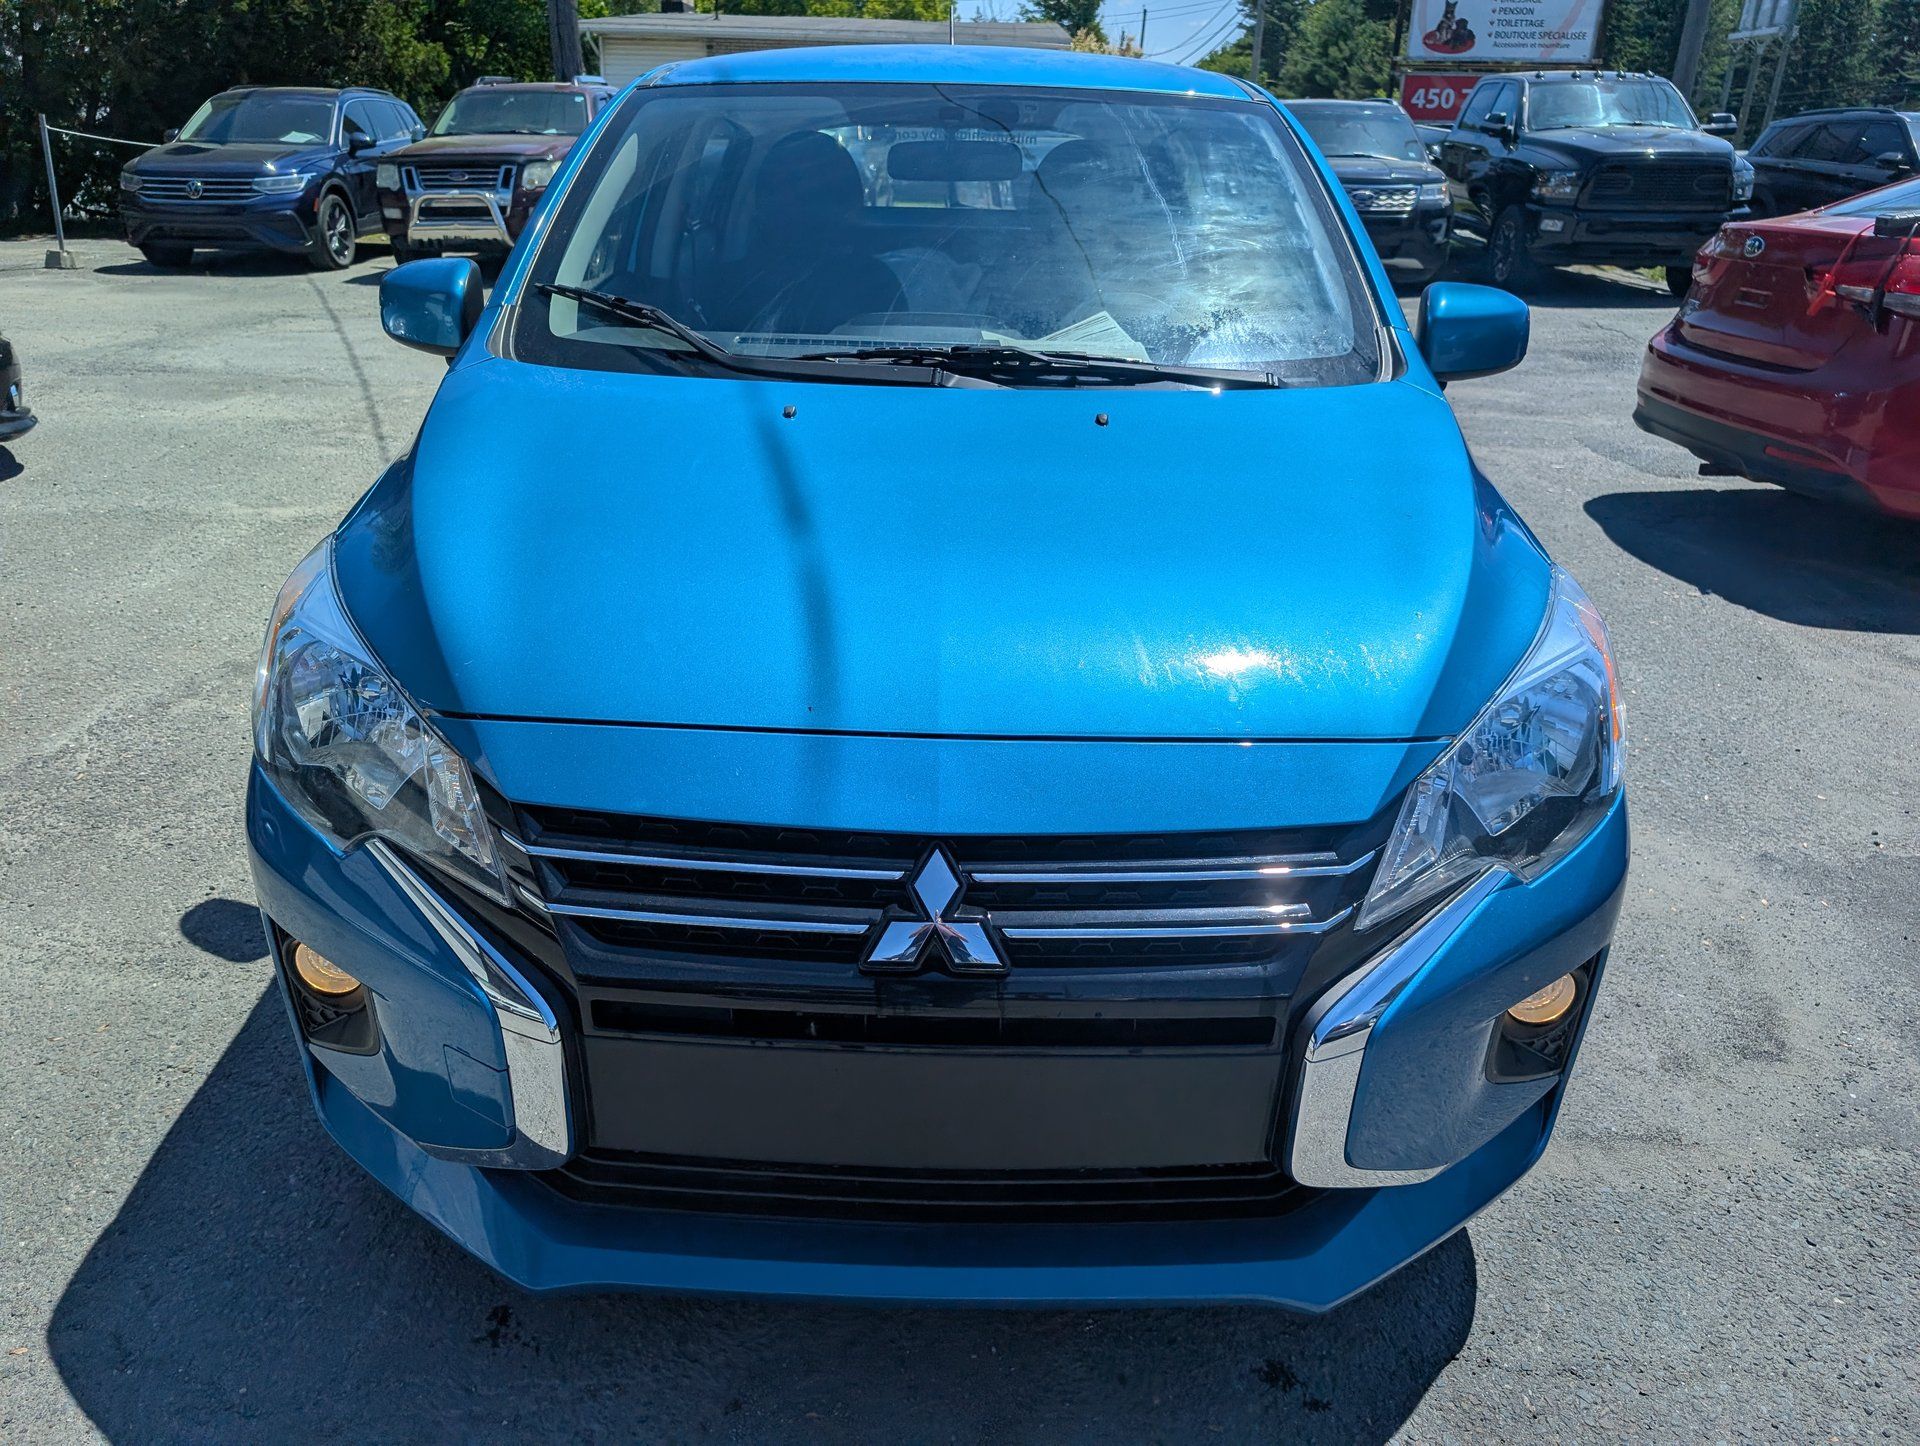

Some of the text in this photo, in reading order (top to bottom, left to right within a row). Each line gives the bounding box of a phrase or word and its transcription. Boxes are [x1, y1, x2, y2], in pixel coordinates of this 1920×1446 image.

[1498, 7, 1534, 15] PENSION
[1496, 19, 1544, 27] TOILETTAGE
[1494, 31, 1536, 40] BOUTIQUE
[1410, 88, 1455, 109] 450
